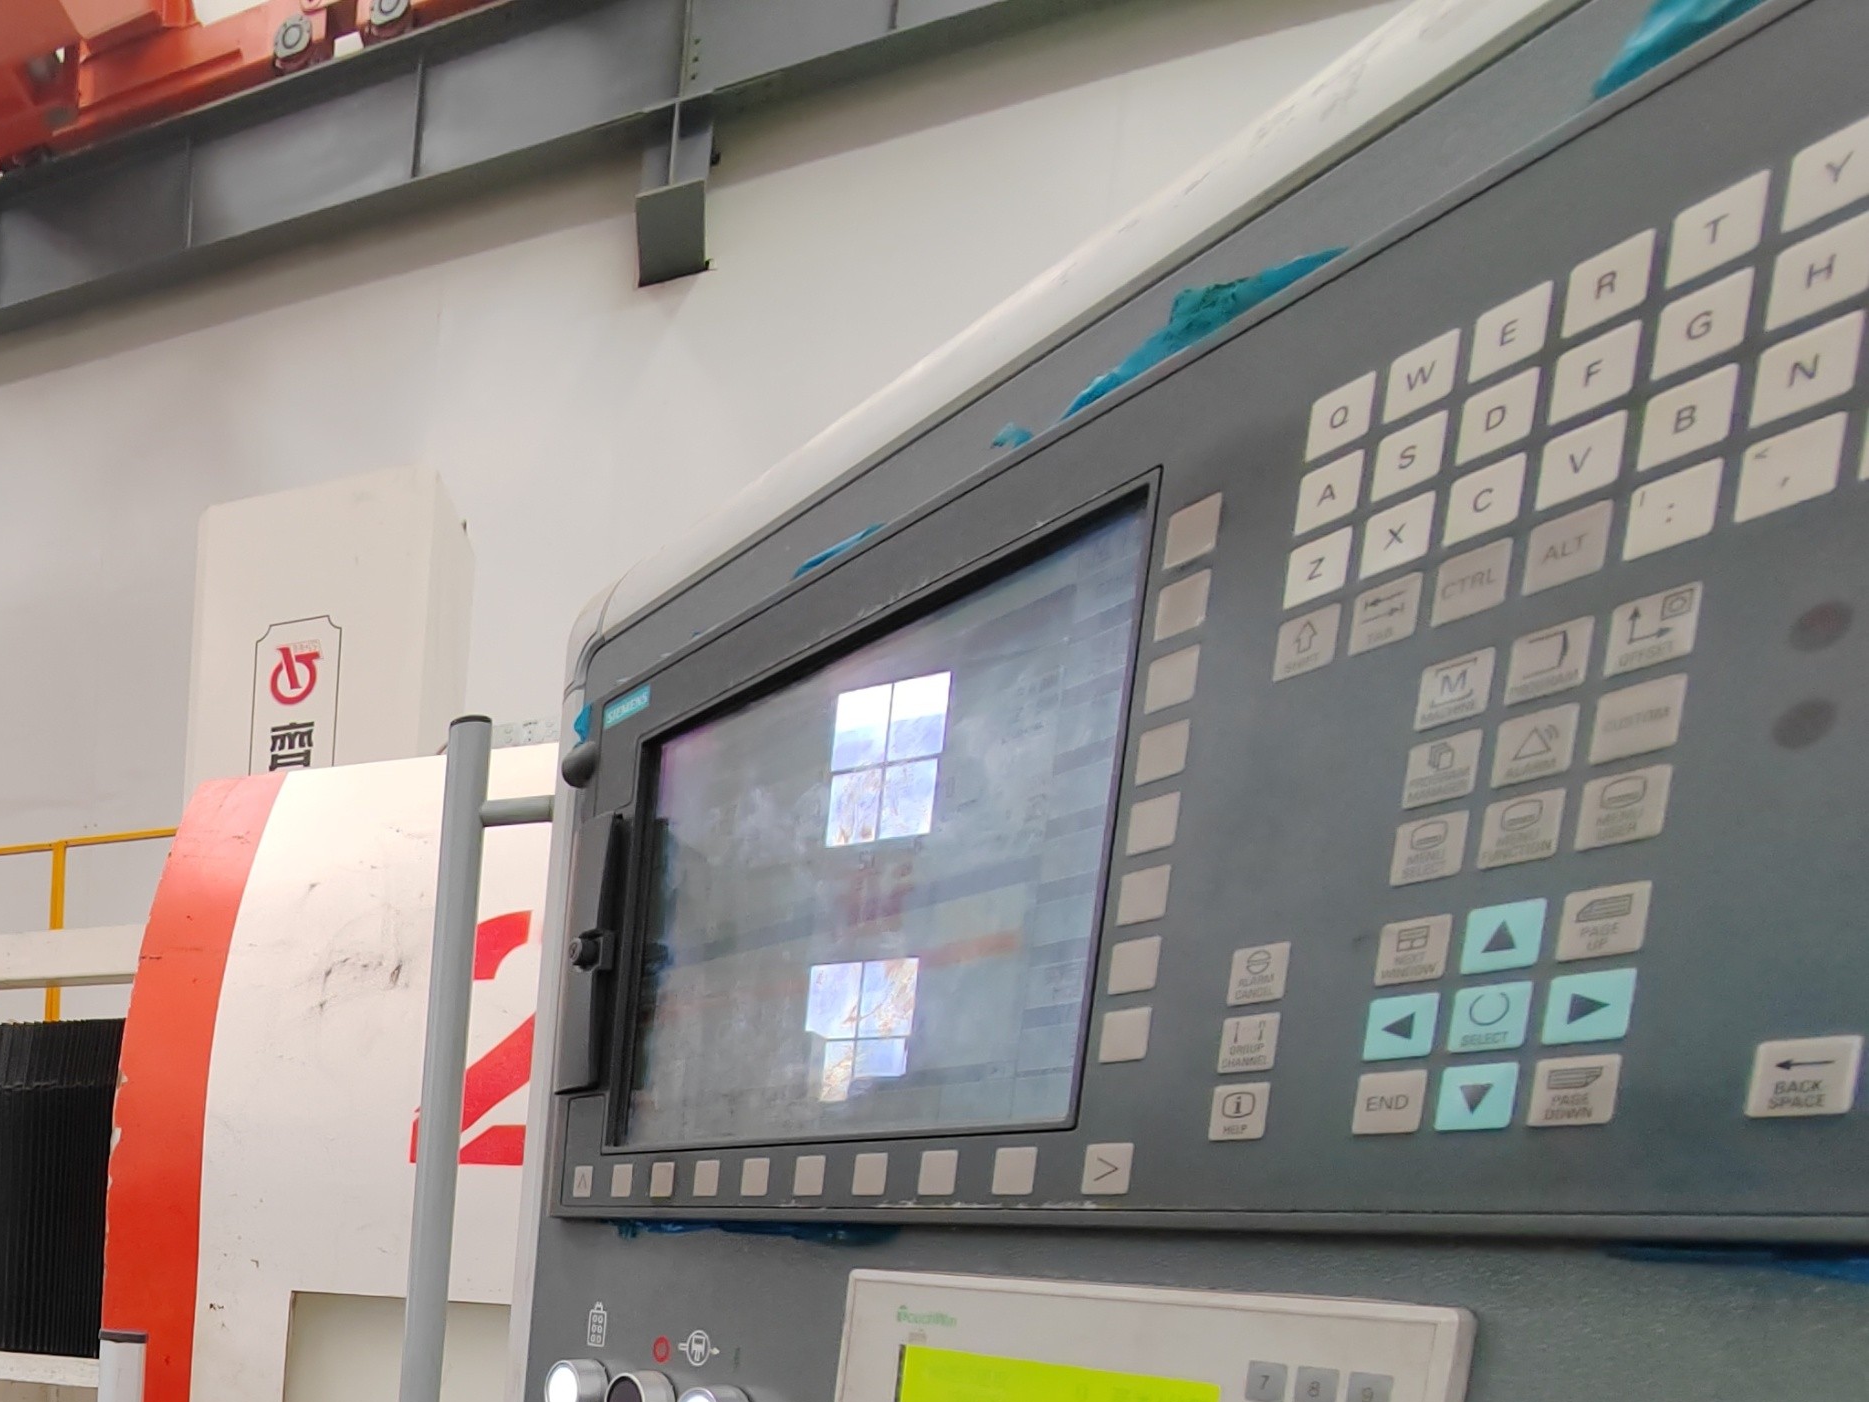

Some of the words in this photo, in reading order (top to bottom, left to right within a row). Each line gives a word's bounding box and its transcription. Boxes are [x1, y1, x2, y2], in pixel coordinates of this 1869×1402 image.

[1824, 151, 1854, 184] Y
[1705, 213, 1729, 245] T
[1805, 253, 1837, 289] H
[1595, 270, 1617, 300] R
[1499, 319, 1518, 347] E
[1685, 310, 1713, 341] G
[1406, 360, 1436, 388] W
[1583, 359, 1603, 387] F
[1788, 353, 1820, 387] N
[1329, 405, 1349, 430] Q
[1484, 405, 1507, 432] D
[1673, 404, 1697, 434] B
[1398, 444, 1417, 470] S
[1569, 446, 1591, 474] V
[1317, 483, 1336, 506] A
[1472, 487, 1494, 514] C
[1384, 523, 1405, 549] X
[1541, 533, 1589, 564] ALT
[1307, 556, 1325, 581] Z
[1440, 566, 1497, 601] CTRL
[607, 691, 649, 723] SIEMENS
[1579, 921, 1620, 938] PAGE
[1460, 1030, 1509, 1048] SELECT
[1774, 1080, 1823, 1095] BACK
[1365, 1094, 1409, 1112] END
[1768, 1093, 1826, 1110] SPACE
[1222, 1124, 1248, 1135] HELP
[1260, 1374, 1270, 1390] 7
[1306, 1380, 1321, 1398] 8
